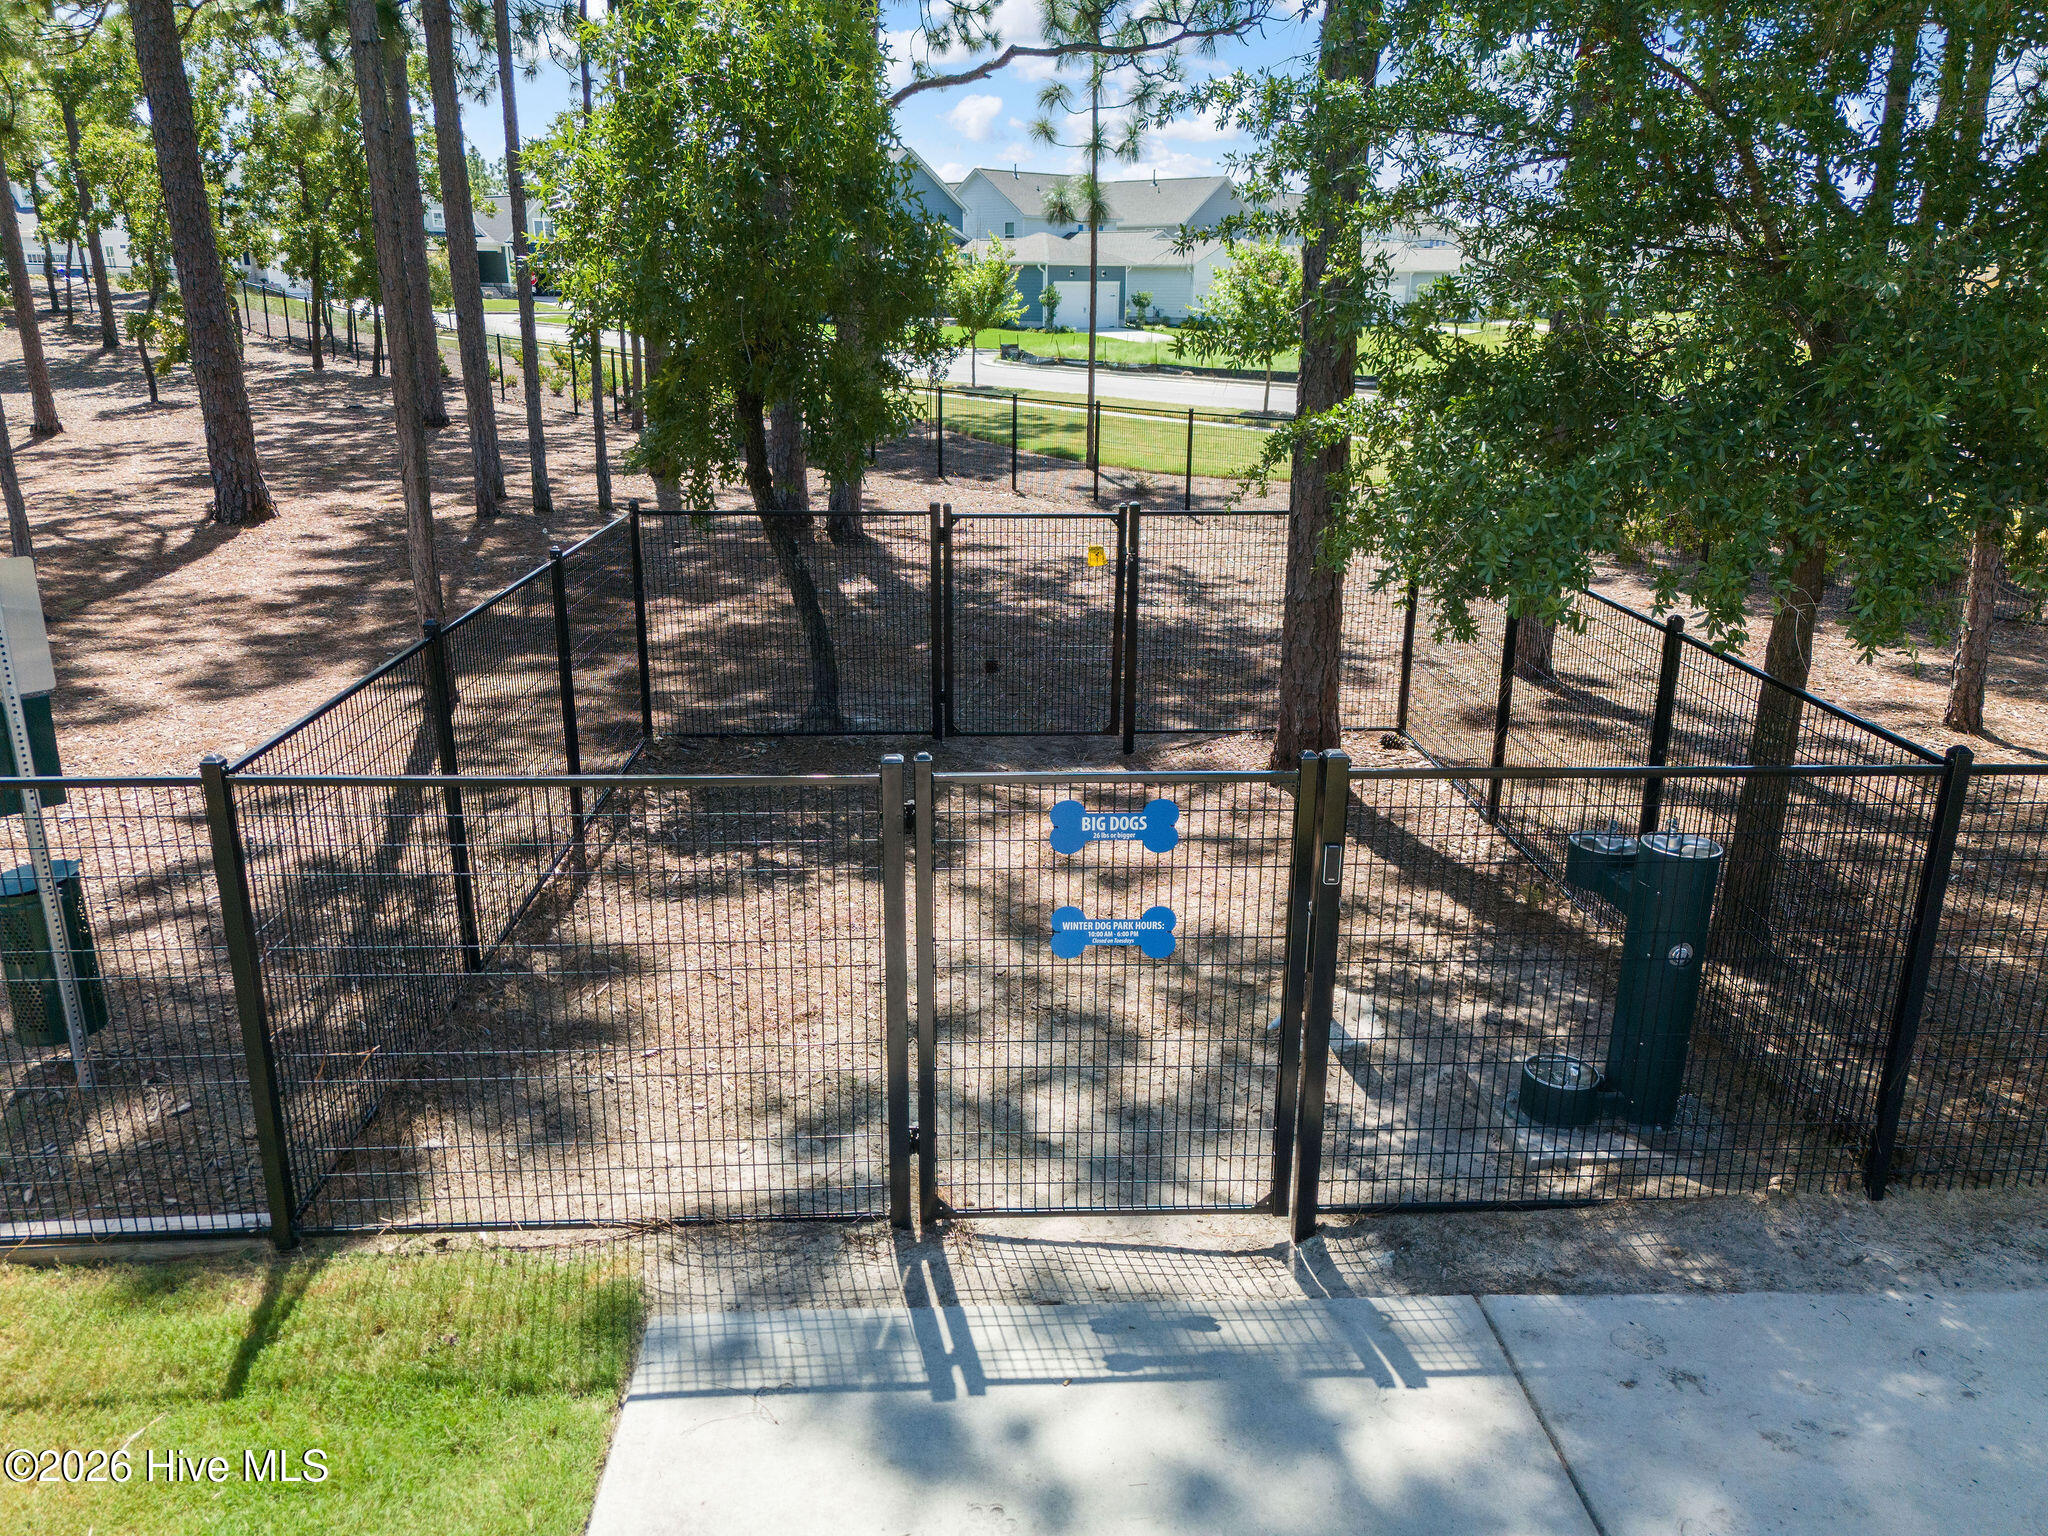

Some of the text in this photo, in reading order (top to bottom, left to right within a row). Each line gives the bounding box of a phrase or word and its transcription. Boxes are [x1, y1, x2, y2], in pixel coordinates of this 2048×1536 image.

[1081, 815, 1148, 831] BIG DOGS
[1117, 832, 1136, 840] bigger
[1062, 921, 1165, 930] WINTER DOG PARK HOURS:
